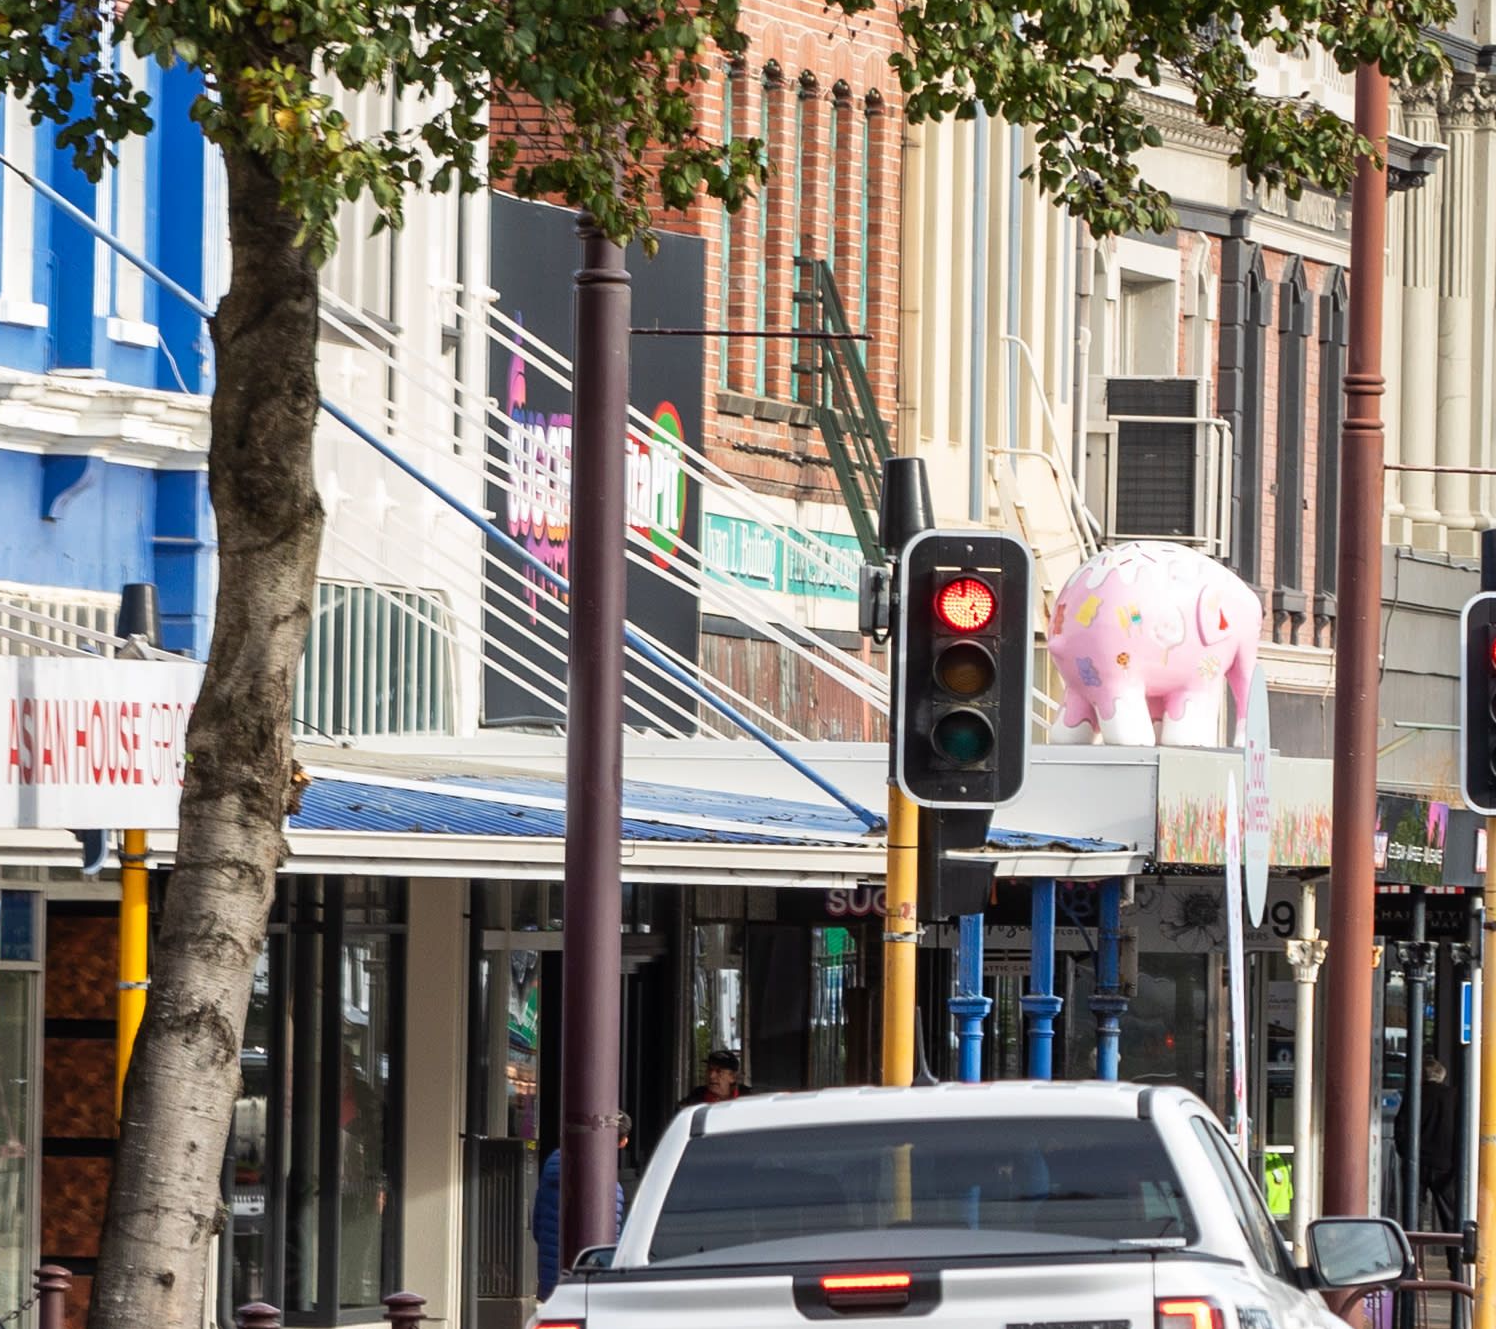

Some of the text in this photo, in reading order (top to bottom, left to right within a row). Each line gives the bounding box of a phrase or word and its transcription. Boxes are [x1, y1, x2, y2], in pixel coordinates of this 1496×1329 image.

[8, 698, 68, 785] ASIAN
[75, 699, 144, 786] HOUSE
[149, 701, 196, 791] GRO
[1382, 911, 1411, 919] HAI
